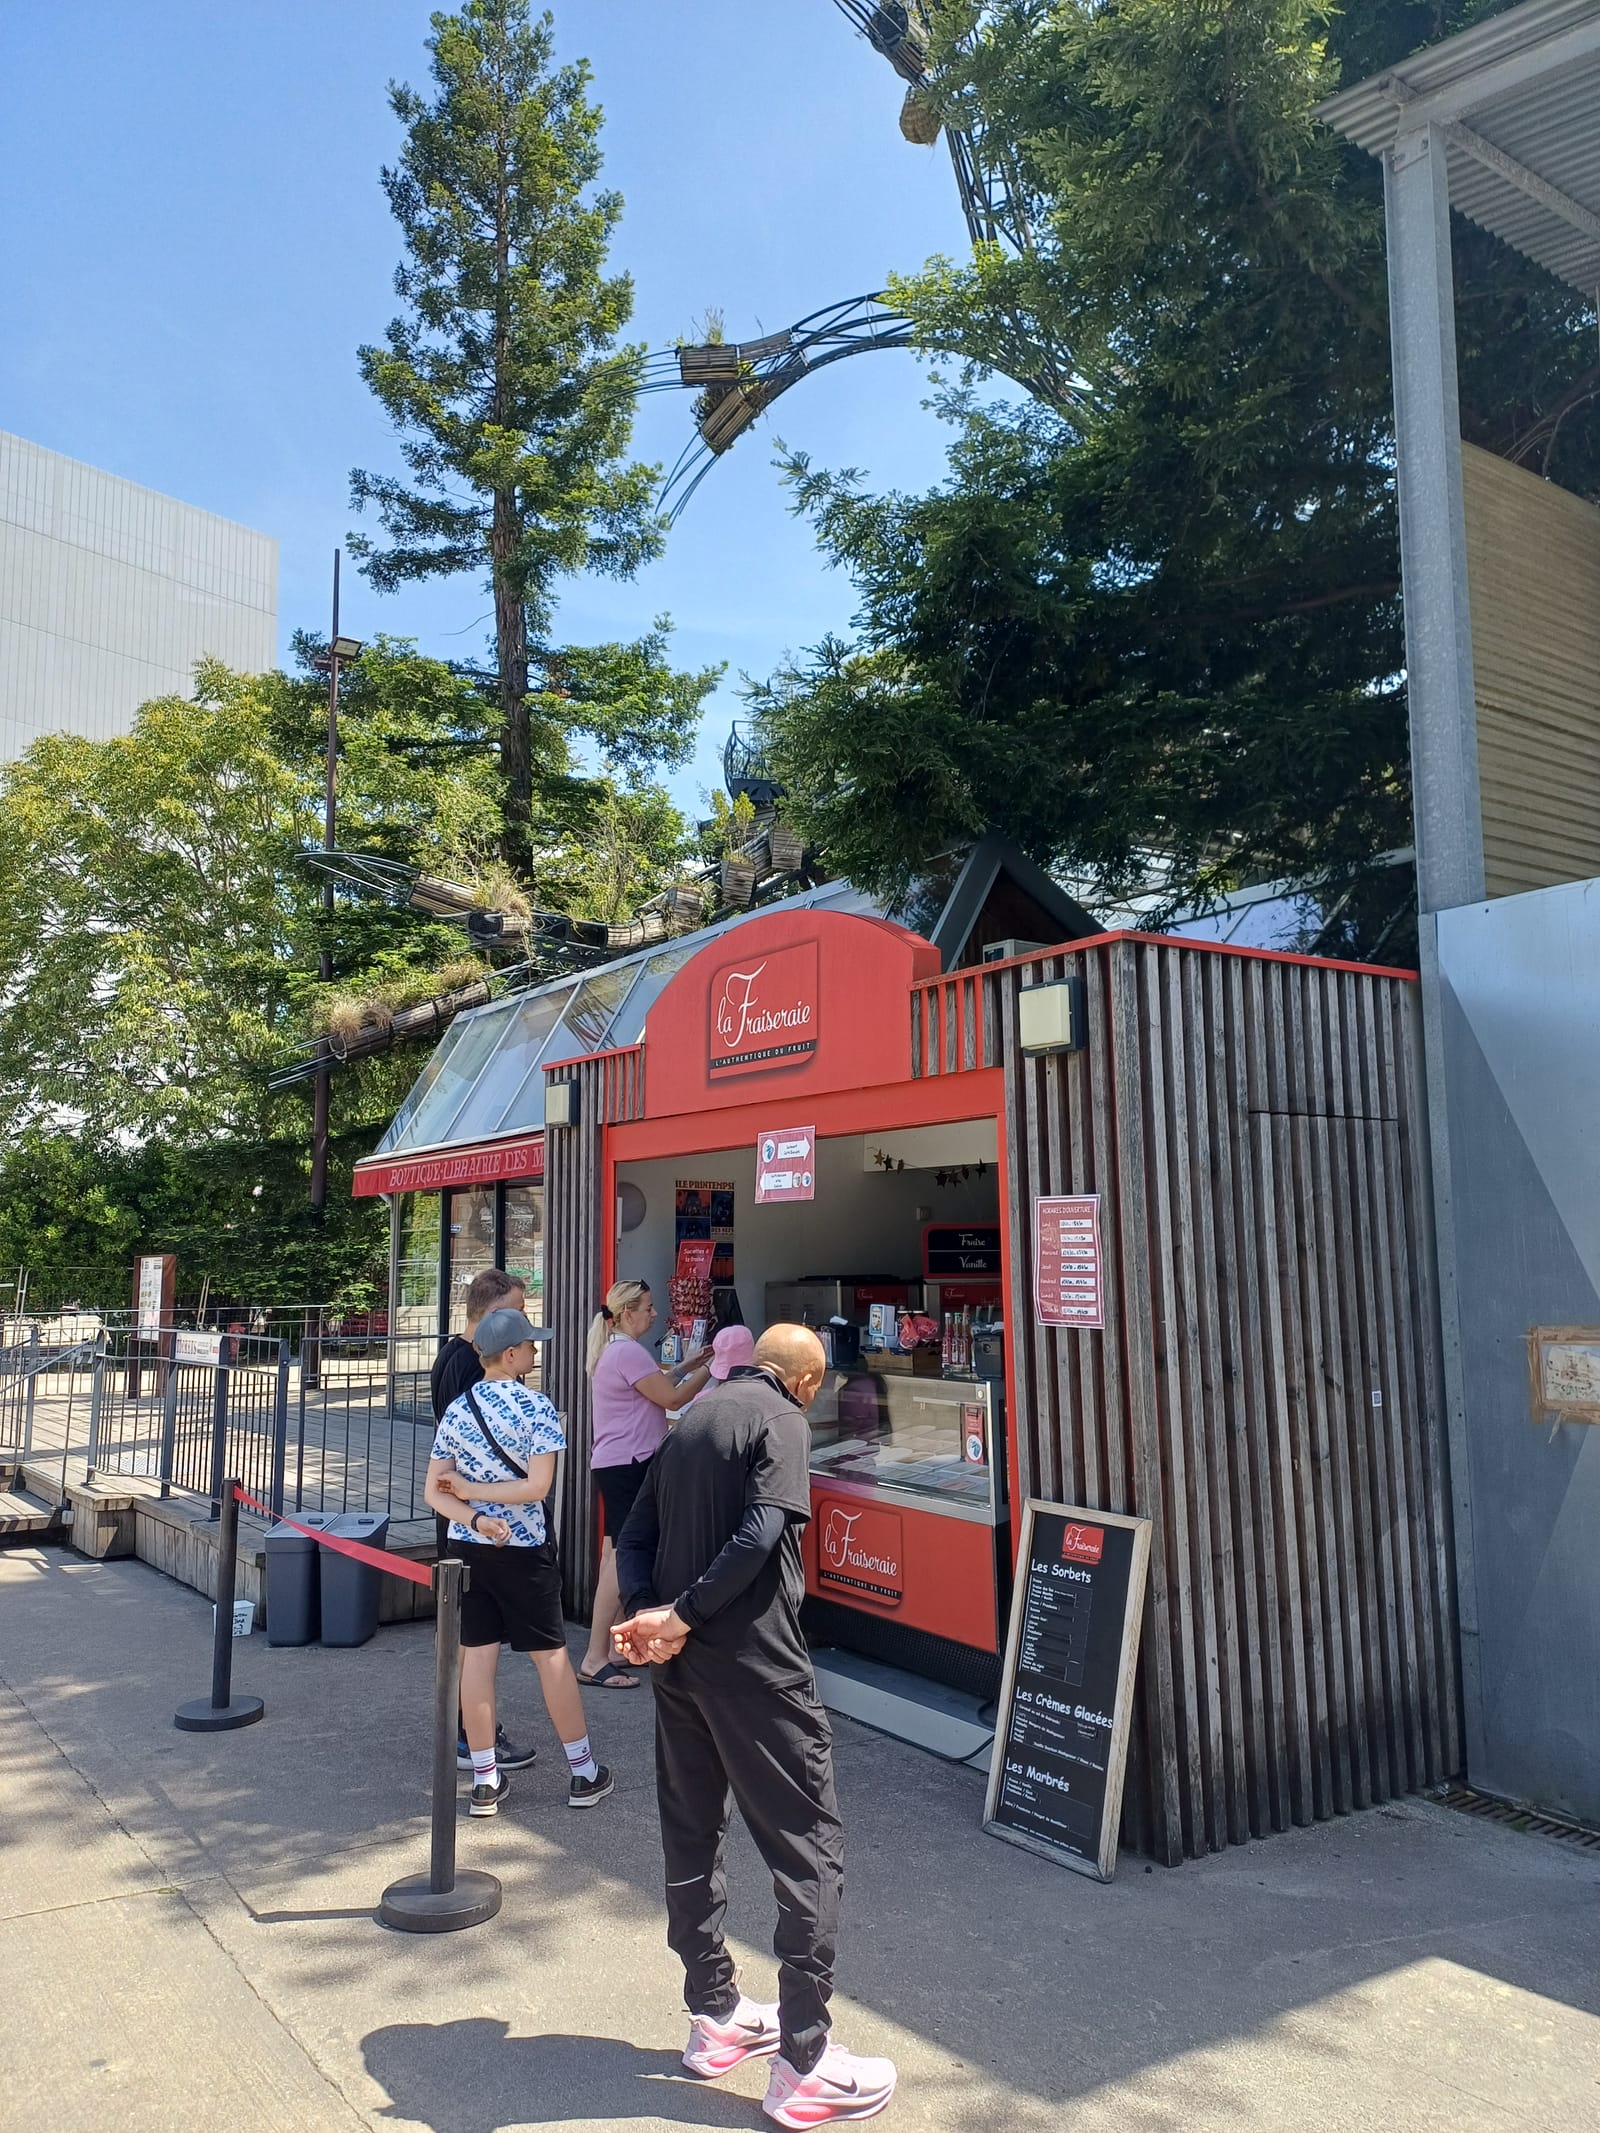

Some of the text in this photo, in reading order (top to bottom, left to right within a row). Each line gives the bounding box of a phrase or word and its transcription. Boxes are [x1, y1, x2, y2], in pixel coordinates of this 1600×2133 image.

[716, 960, 810, 1047] la Fraiseraie
[715, 1049, 771, 1066] L'AUTHENTIQUE
[788, 1042, 811, 1053] FRUIT
[503, 1149, 528, 1172] DES
[958, 1233, 986, 1246] Fraise
[959, 1255, 987, 1268] Vanille
[825, 1508, 897, 1576] la Fraiseraie
[1031, 1558, 1092, 1584] Les Sorbets
[1016, 1686, 1113, 1729] Les Crèmes Glacées
[1006, 1757, 1070, 1792] Les Marbrés
